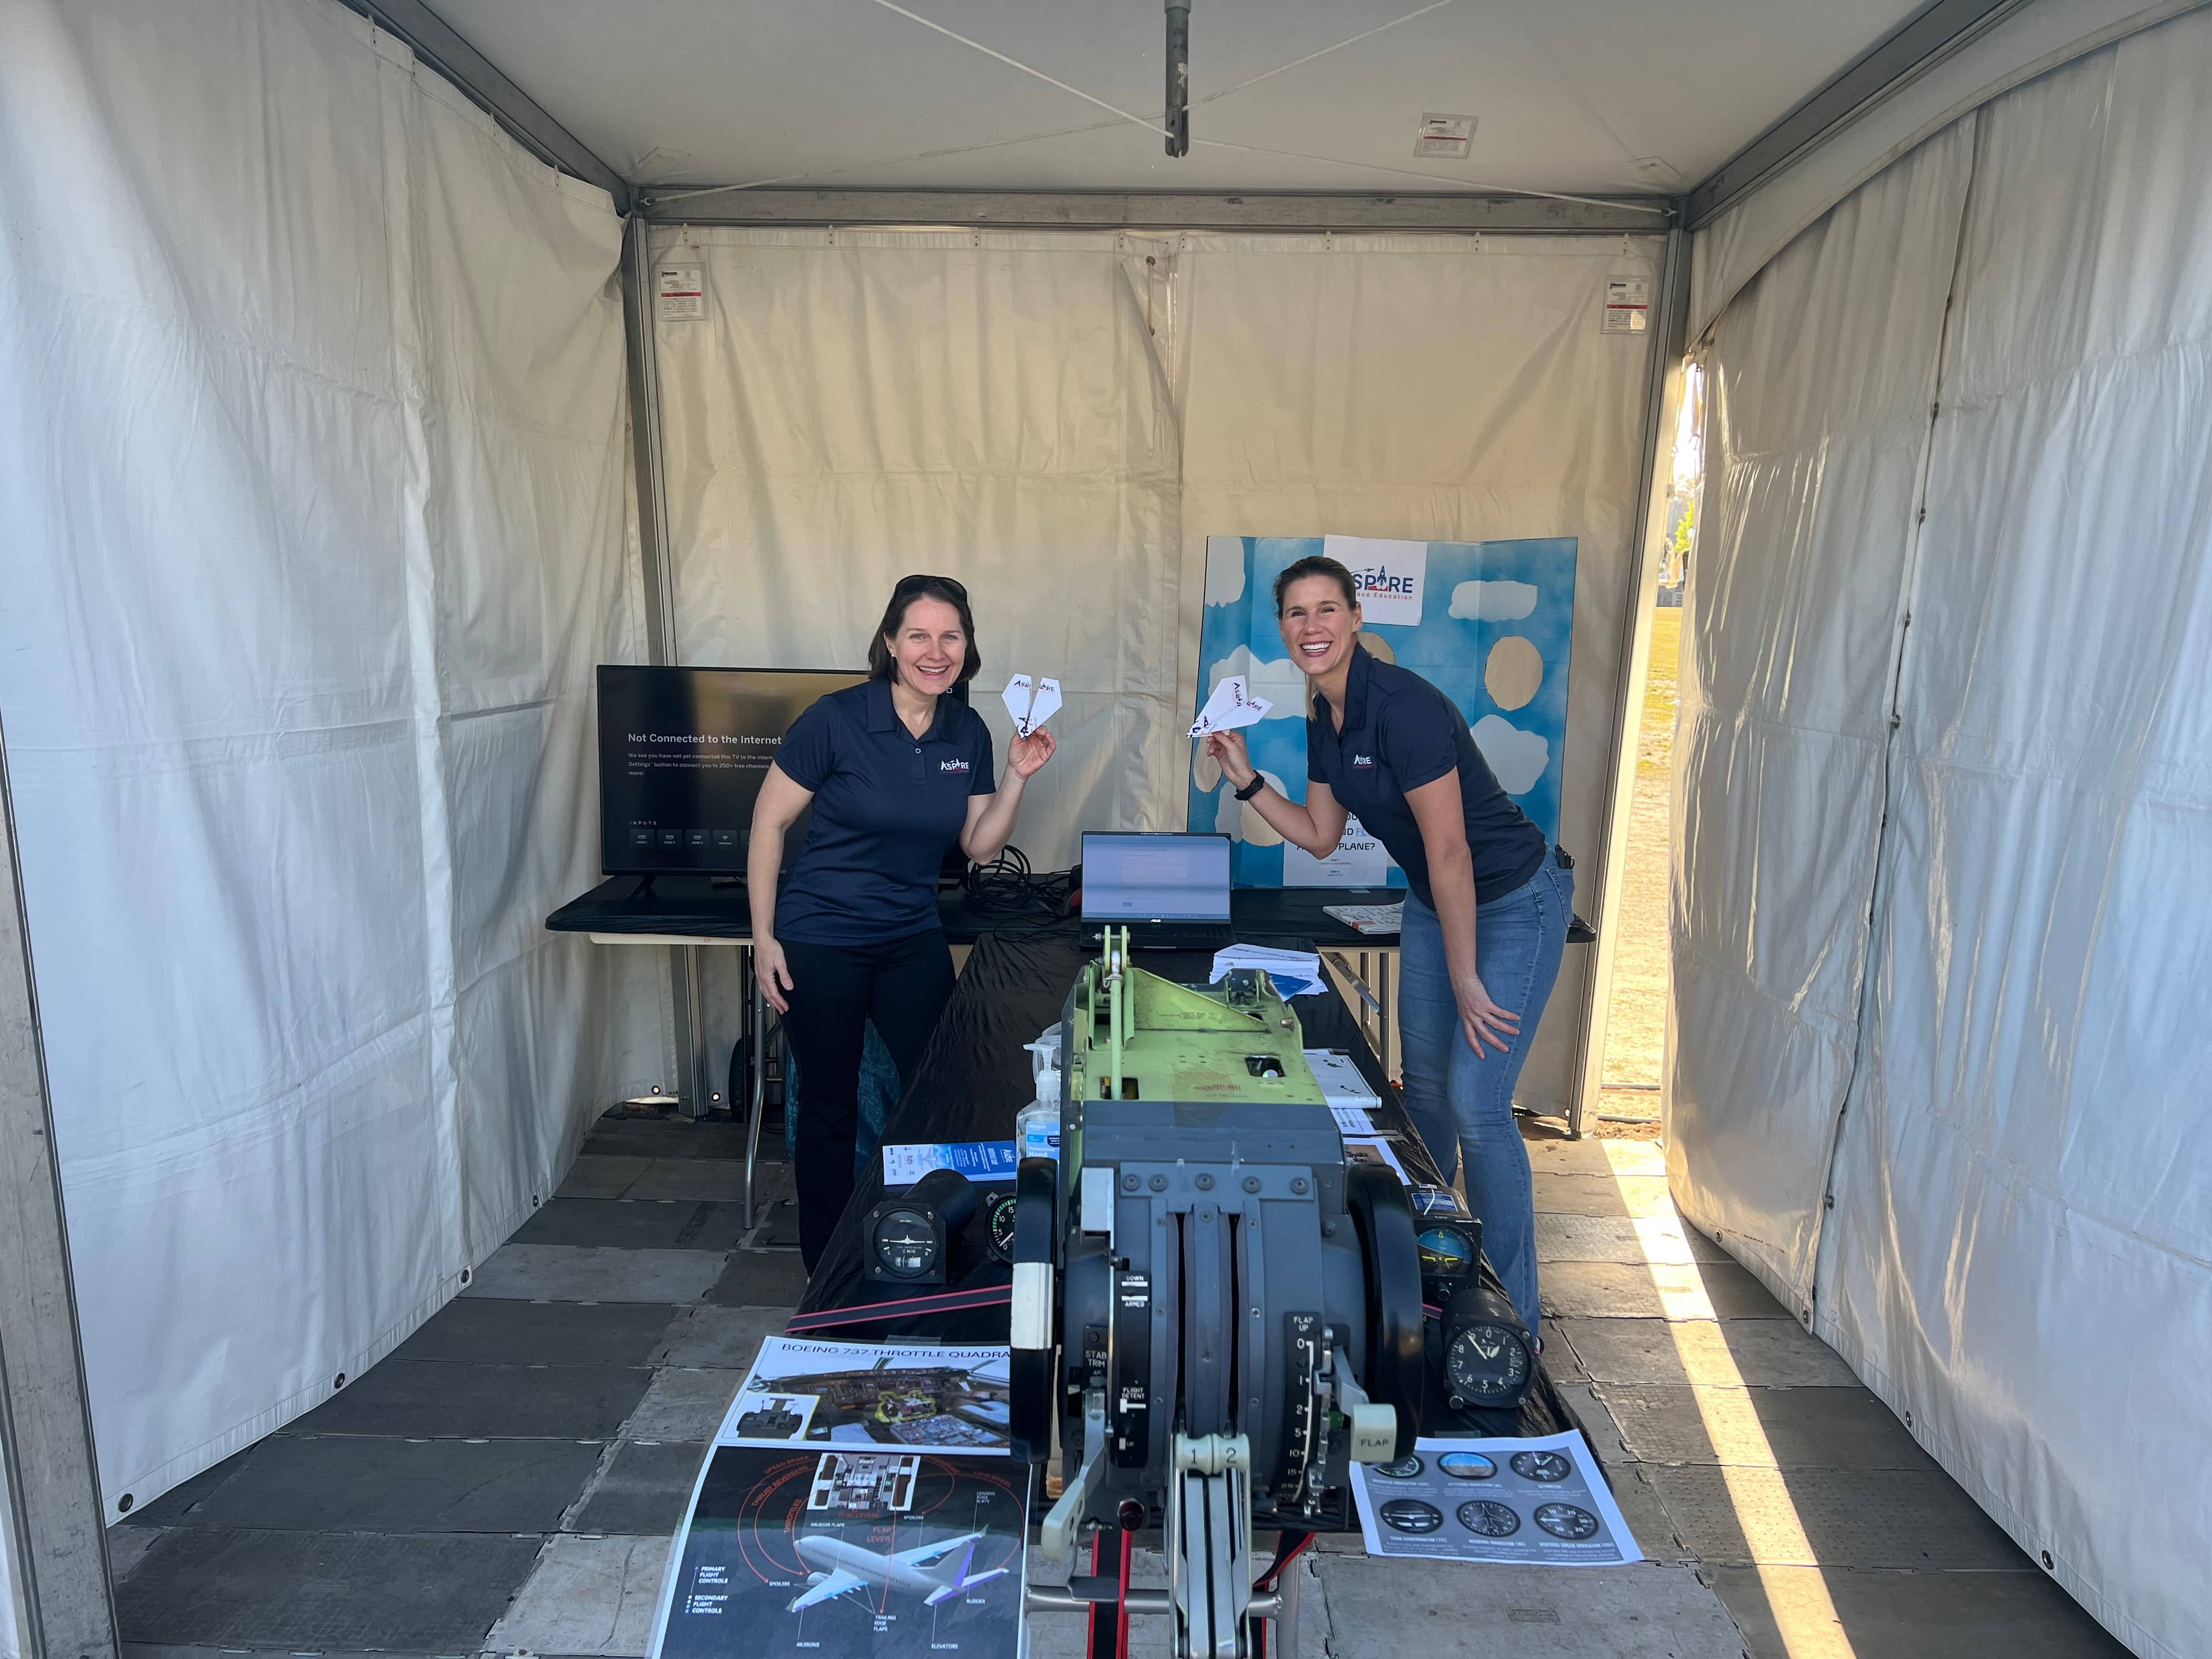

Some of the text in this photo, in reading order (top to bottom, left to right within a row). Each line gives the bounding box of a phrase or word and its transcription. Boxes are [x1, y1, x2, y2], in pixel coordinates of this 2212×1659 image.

[1353, 565, 1414, 593] SPIRE
[1374, 592, 1412, 600] Education
[628, 733, 782, 744] Not Connected to the Internet
[1486, 1330, 1491, 1338] 0
[1297, 1338, 1305, 1350] 0
[1503, 1336, 1506, 1345] 1
[782, 1343, 839, 1354] BOEING
[873, 1349, 945, 1358] THROTTLE
[1459, 1344, 1464, 1353] 8
[1510, 1347, 1516, 1356] 2
[1085, 1350, 1107, 1359] STAB
[1088, 1359, 1105, 1368] TRIM
[1457, 1360, 1463, 1369] 7
[1508, 1368, 1514, 1377] 3
[1300, 1374, 1303, 1386] 1
[1467, 1374, 1473, 1382] 6
[1482, 1380, 1488, 1389] 5
[1297, 1404, 1302, 1415] 2
[1295, 1427, 1301, 1438] 5
[1361, 1438, 1389, 1447] FLAP
[1191, 1448, 1197, 1465] 1
[1226, 1447, 1236, 1463] 2
[1290, 1449, 1300, 1458] 10
[751, 1485, 774, 1507] THRUST
[783, 1498, 801, 1533] THROTTLES
